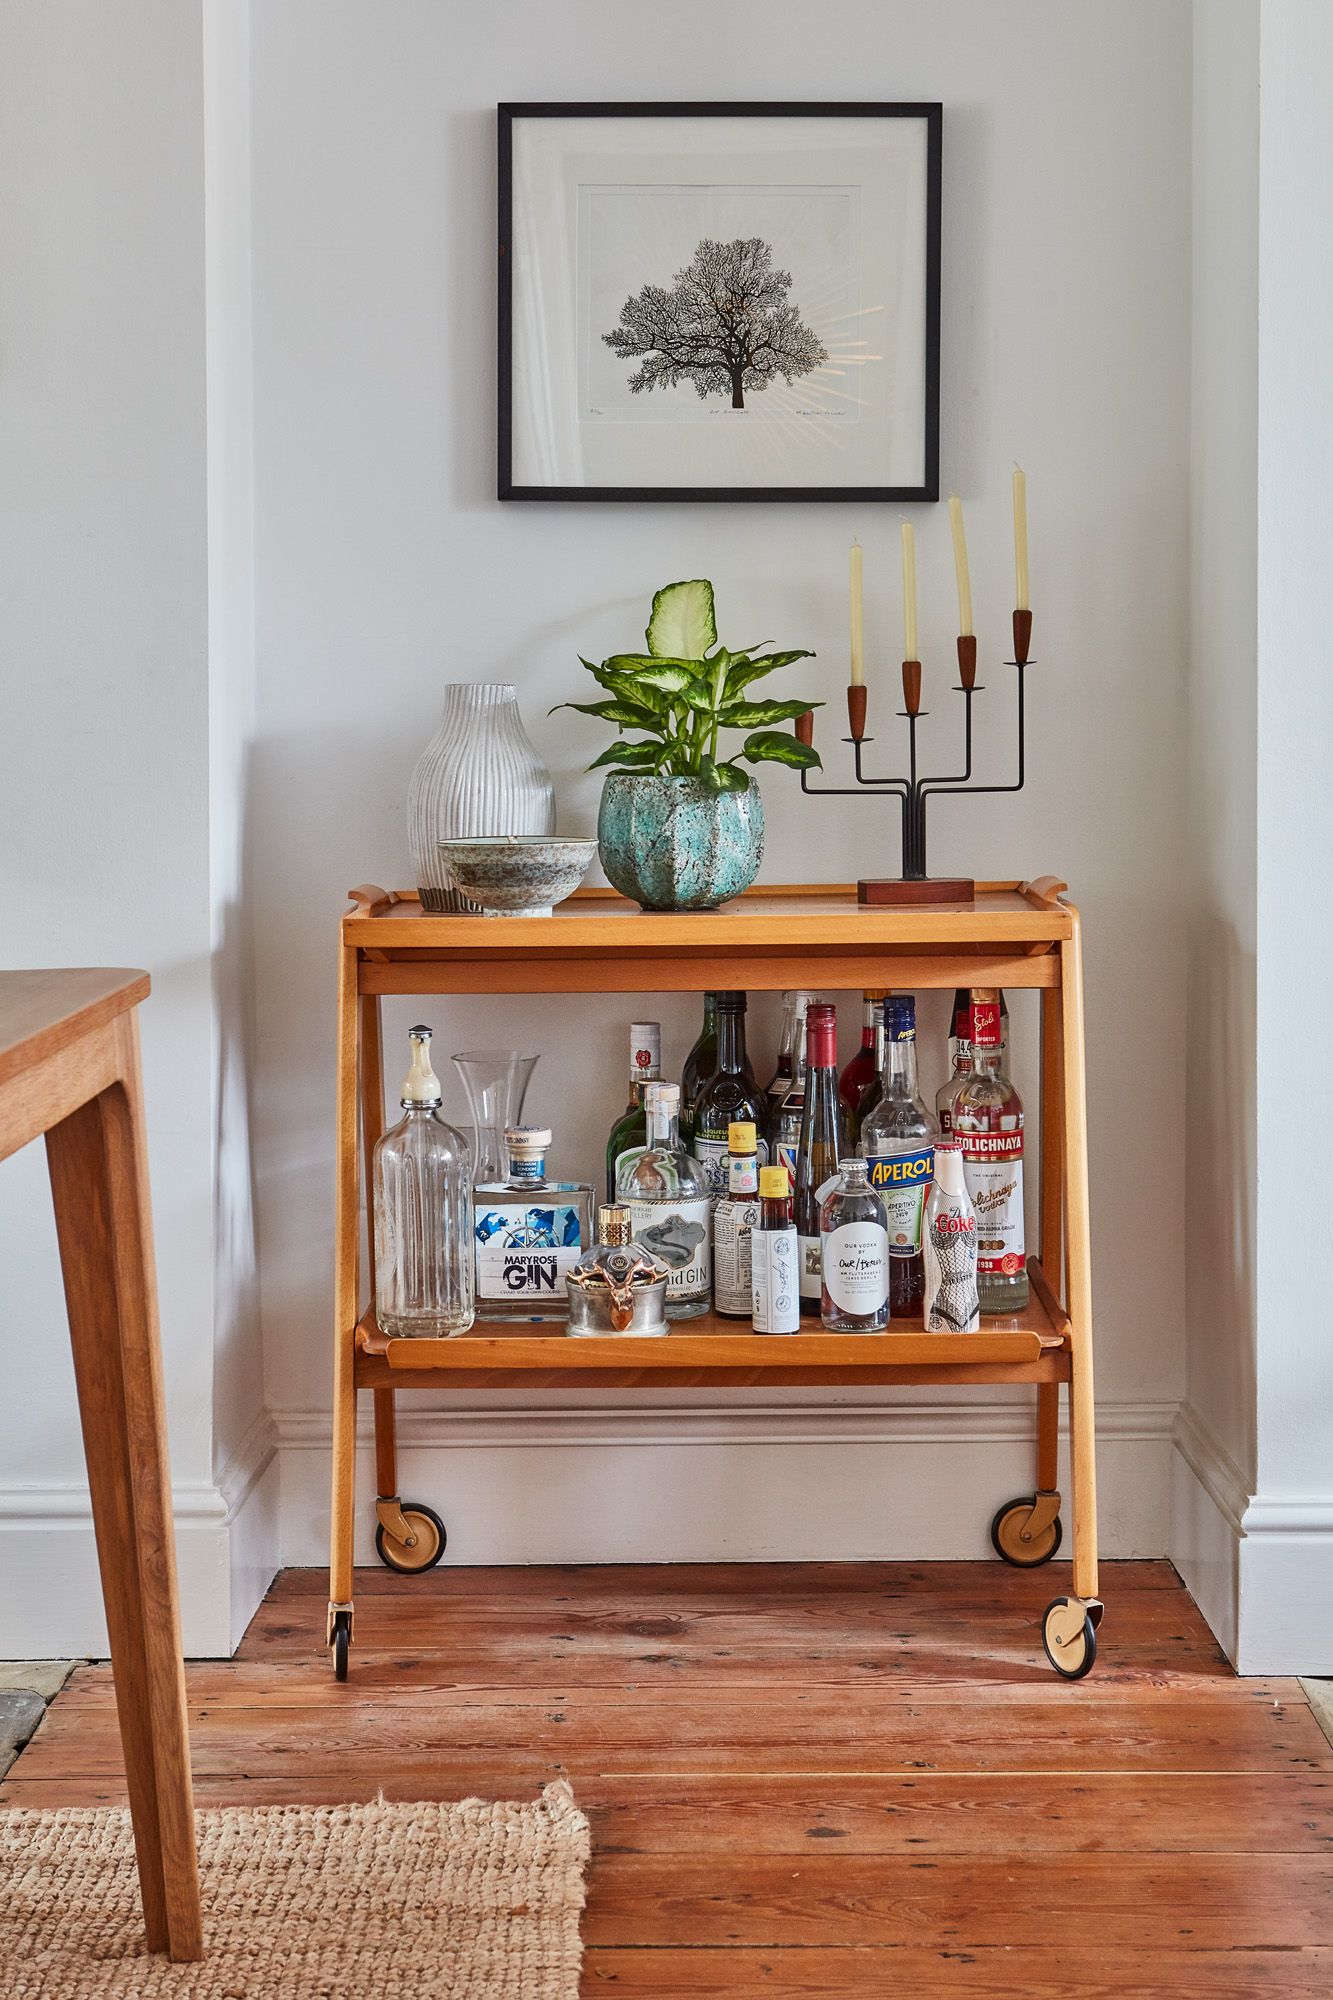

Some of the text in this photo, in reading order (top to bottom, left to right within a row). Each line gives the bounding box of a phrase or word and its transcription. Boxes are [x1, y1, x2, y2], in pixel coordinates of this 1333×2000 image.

[872, 1157, 933, 1185] APEROL
[968, 1180, 1018, 1208] olichnaya
[936, 1212, 975, 1233] Coke
[686, 1266, 708, 1284] GIN
[977, 1260, 994, 1269] 1938
[503, 1264, 558, 1290] GIN
